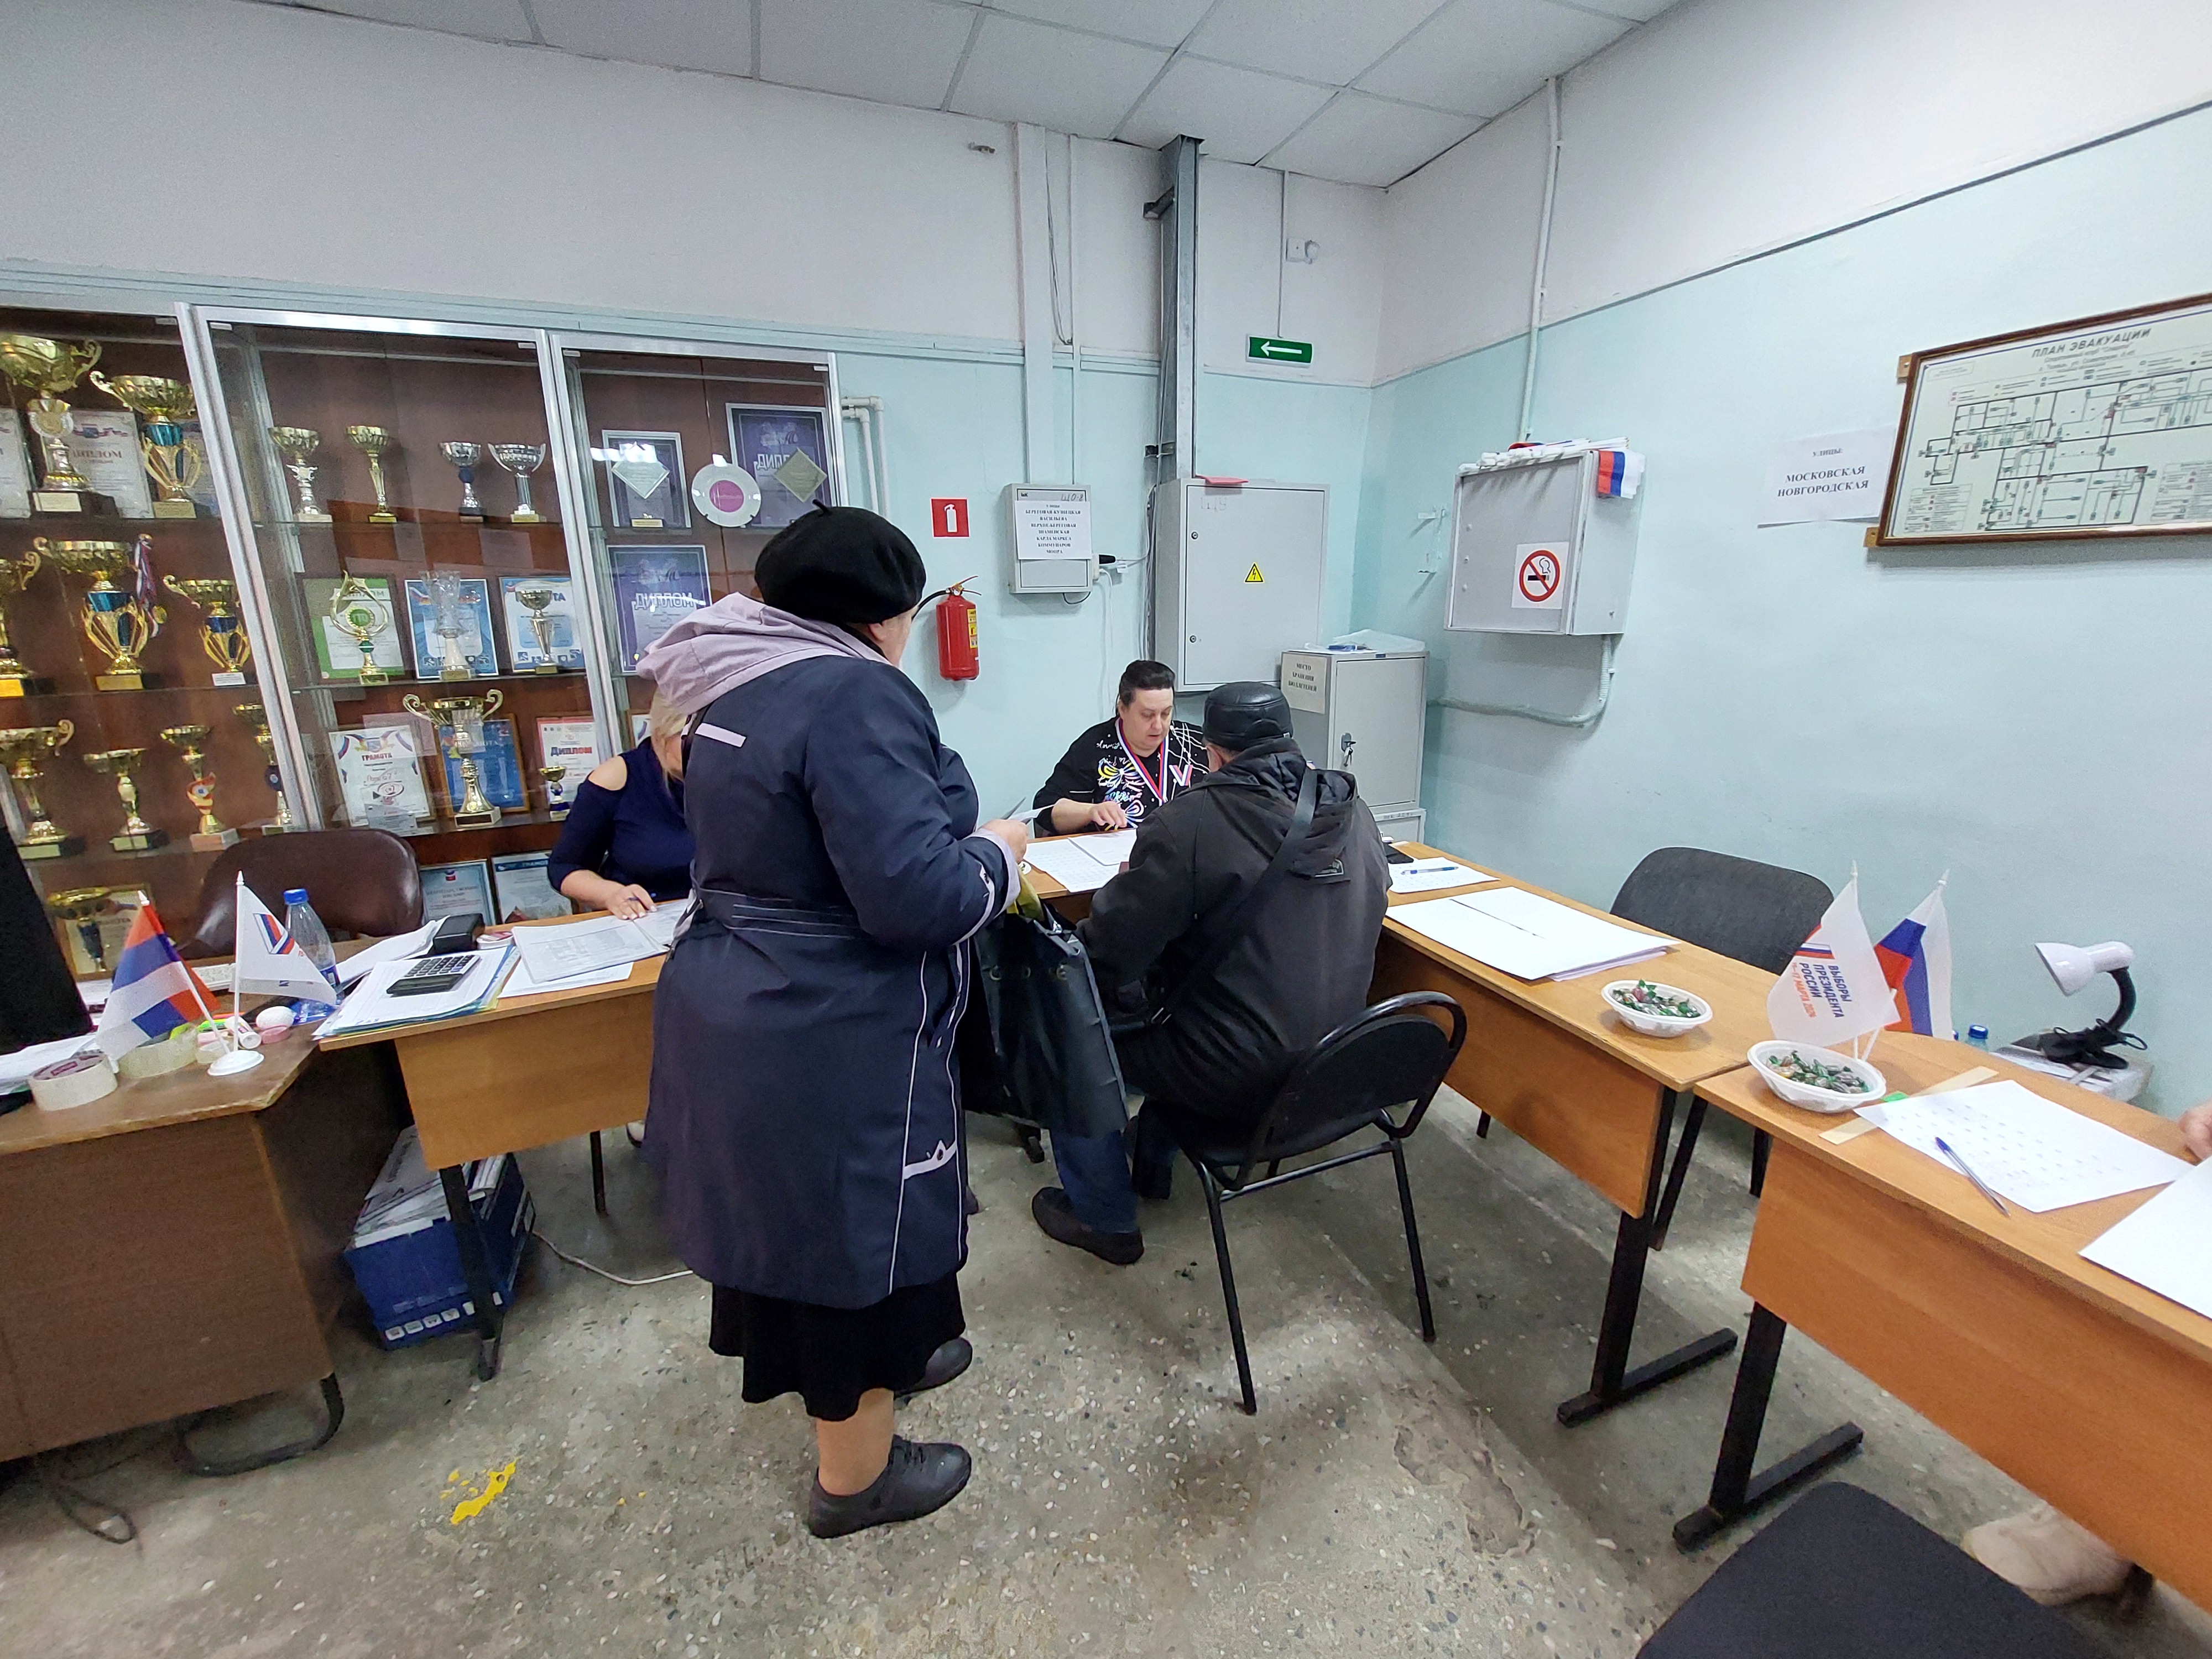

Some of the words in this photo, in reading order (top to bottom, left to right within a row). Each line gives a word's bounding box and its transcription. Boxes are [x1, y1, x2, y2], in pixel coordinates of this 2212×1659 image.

[2031, 344, 2066, 358] ПЛАН
[2069, 328, 2152, 352] ЭВАКУАЦИИ
[1785, 466, 1866, 483] МОСКОВСКАЯ
[1777, 479, 1869, 497] НОВГОРОДСКАЯ
[635, 593, 693, 610] ДИПЛОМ
[362, 753, 392, 761] ГРАМОТА
[1799, 962, 1823, 998] РОССИИ
[1813, 964, 1844, 1018] ПРЕЗИДЕНТА
[1828, 965, 1853, 1002] ВЫБОРЫ
